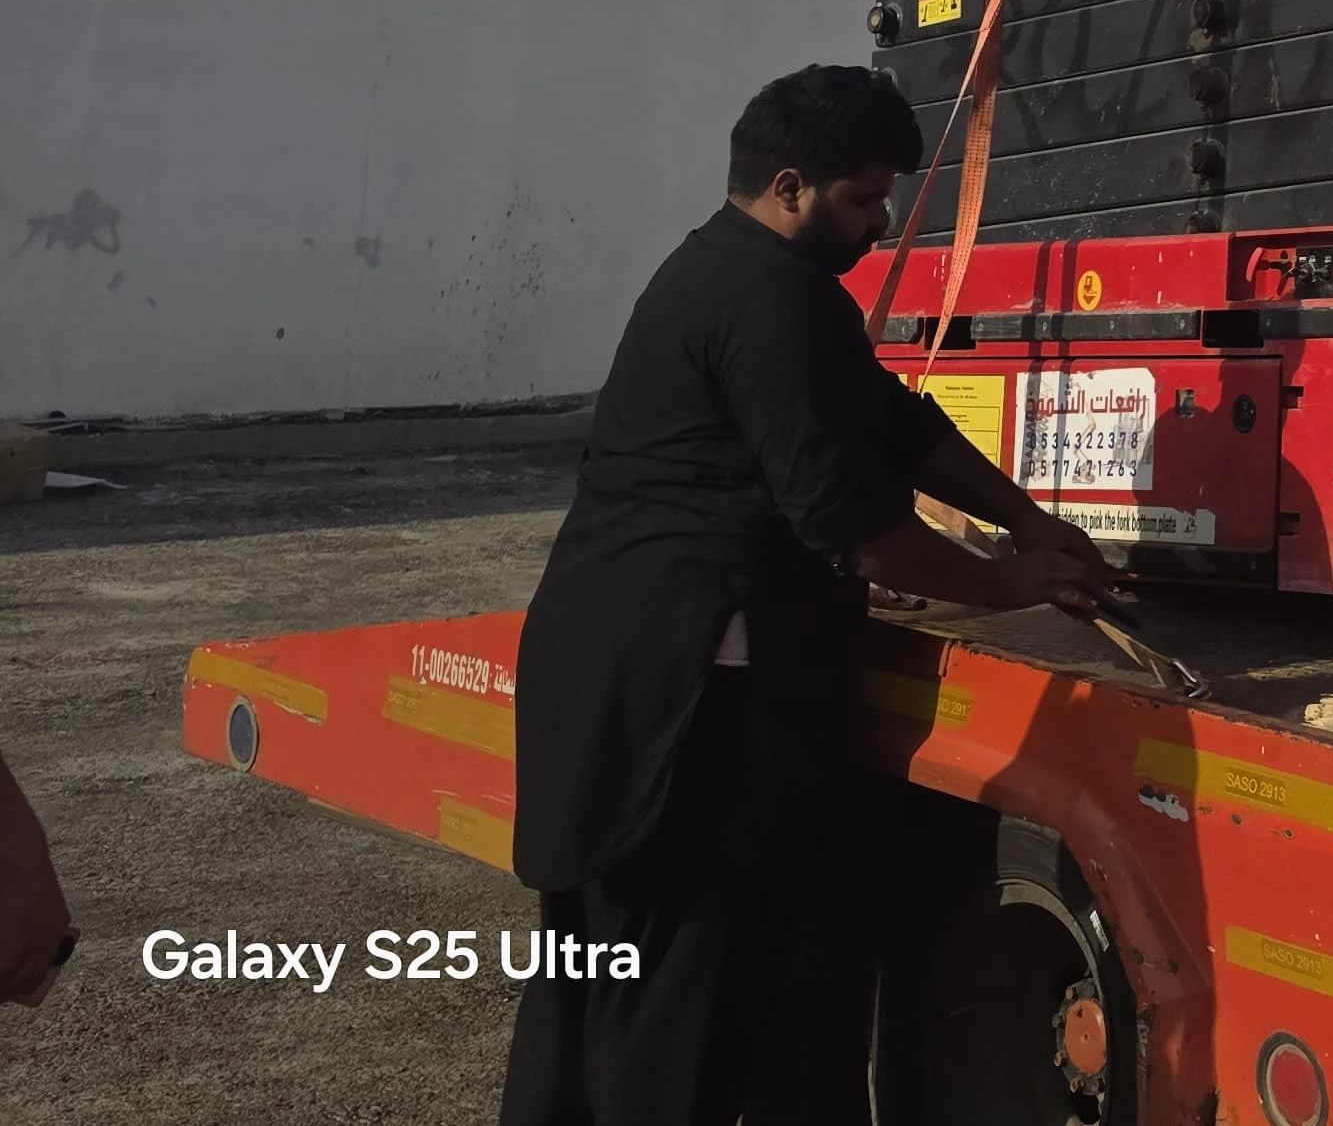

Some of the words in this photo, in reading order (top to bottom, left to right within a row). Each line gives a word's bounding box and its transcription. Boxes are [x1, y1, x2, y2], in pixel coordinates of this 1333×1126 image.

[1090, 388, 1147, 418] رافعات
[1028, 432, 1138, 450] 0534322378
[1029, 460, 1137, 477] 0577471263
[1104, 511, 1116, 531] the
[1117, 510, 1131, 531] fork
[411, 644, 490, 694] 11-00266529
[1226, 772, 1258, 794] SASO
[1259, 781, 1287, 803] 2913
